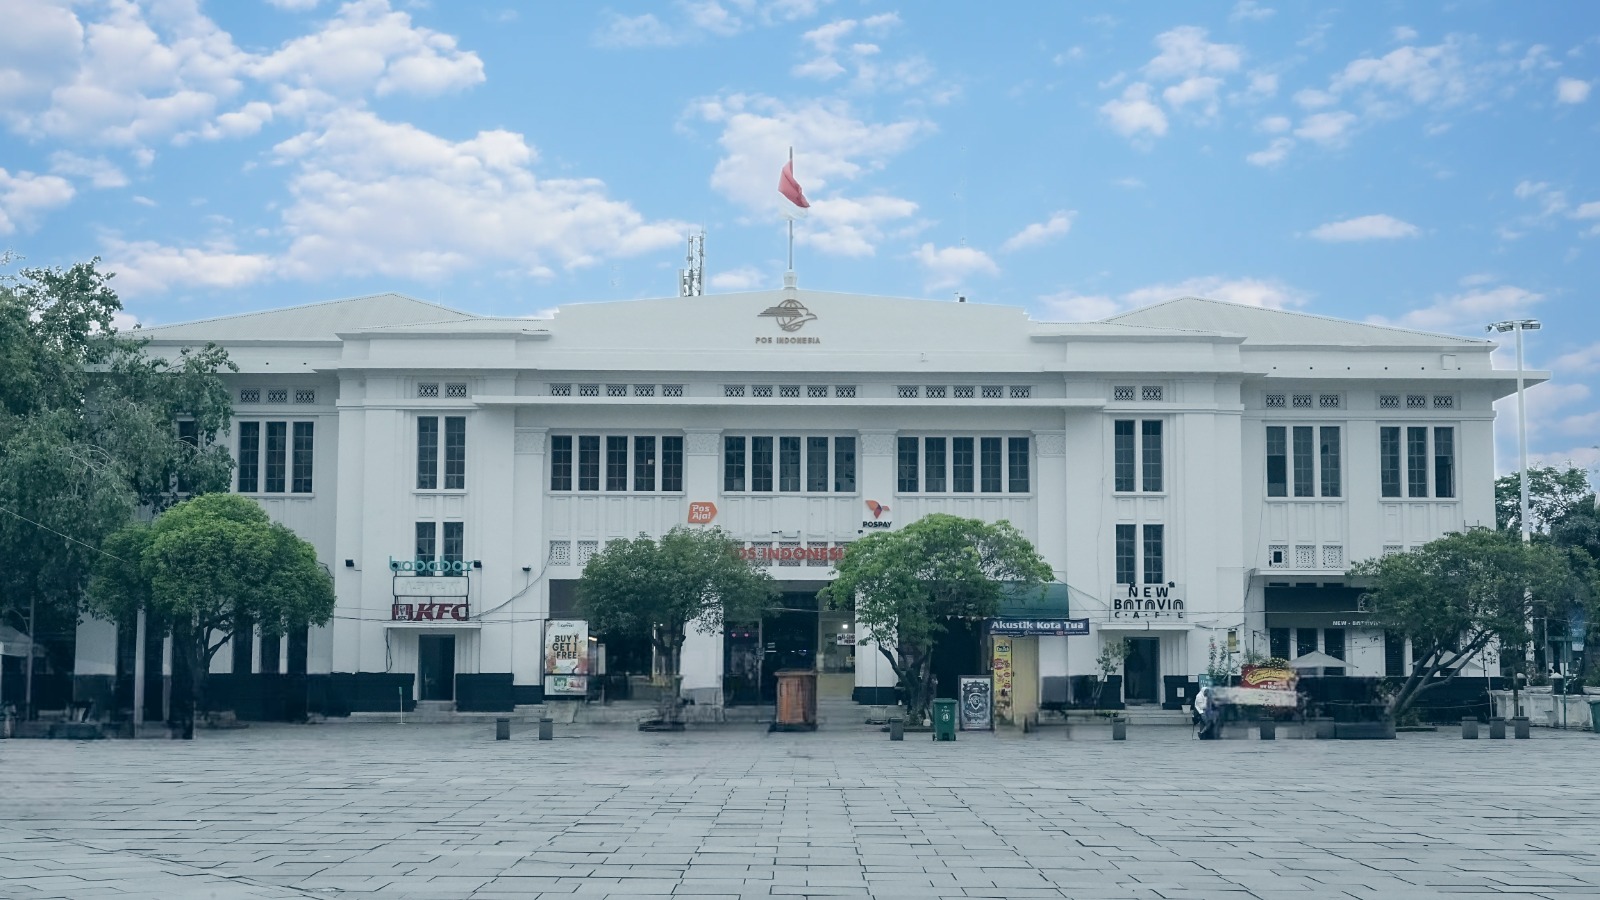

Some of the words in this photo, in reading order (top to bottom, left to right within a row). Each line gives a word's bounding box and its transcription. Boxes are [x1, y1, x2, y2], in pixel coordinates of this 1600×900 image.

[692, 504, 710, 512] Pos
[692, 511, 711, 520] Aja!
[735, 547, 756, 560] OS
[762, 547, 846, 560] INDONESI
[1128, 587, 1168, 597] NEW
[1114, 599, 1184, 610] BATAVIA
[412, 603, 471, 621] KFC
[991, 621, 1034, 629] Akustik
[1036, 621, 1061, 629] Kota
[1063, 621, 1084, 629] Tua
[554, 635, 571, 643] BUY
[552, 642, 571, 651] GET
[556, 651, 577, 659] FREE
